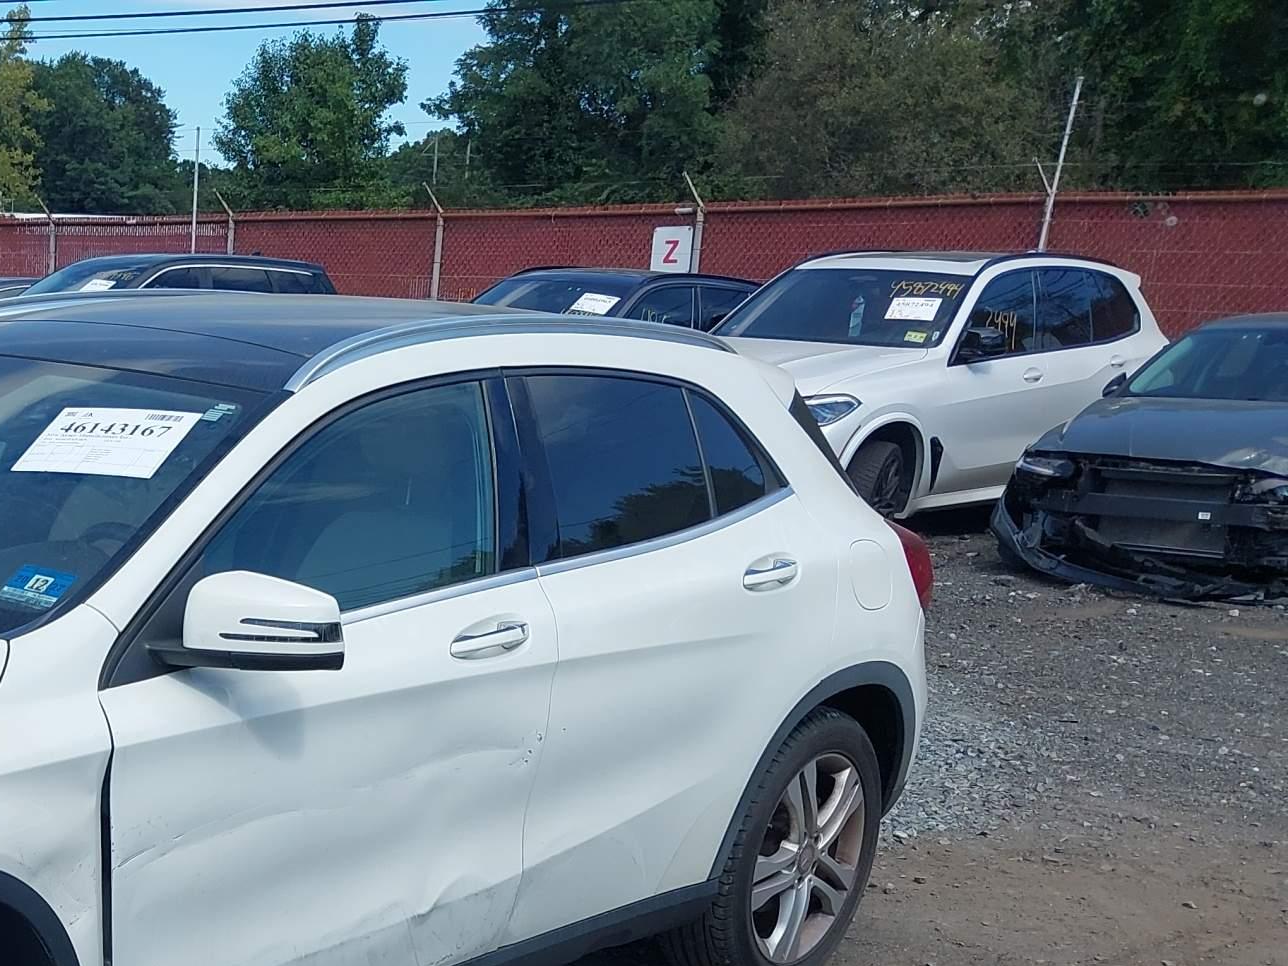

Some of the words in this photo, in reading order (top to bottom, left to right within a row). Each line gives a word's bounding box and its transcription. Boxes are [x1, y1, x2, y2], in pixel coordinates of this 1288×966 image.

[662, 240, 679, 263] Z
[890, 280, 965, 300] 45872494
[984, 305, 1017, 350] 2494
[60, 421, 173, 438] 46143167
[27, 577, 49, 592] 12
